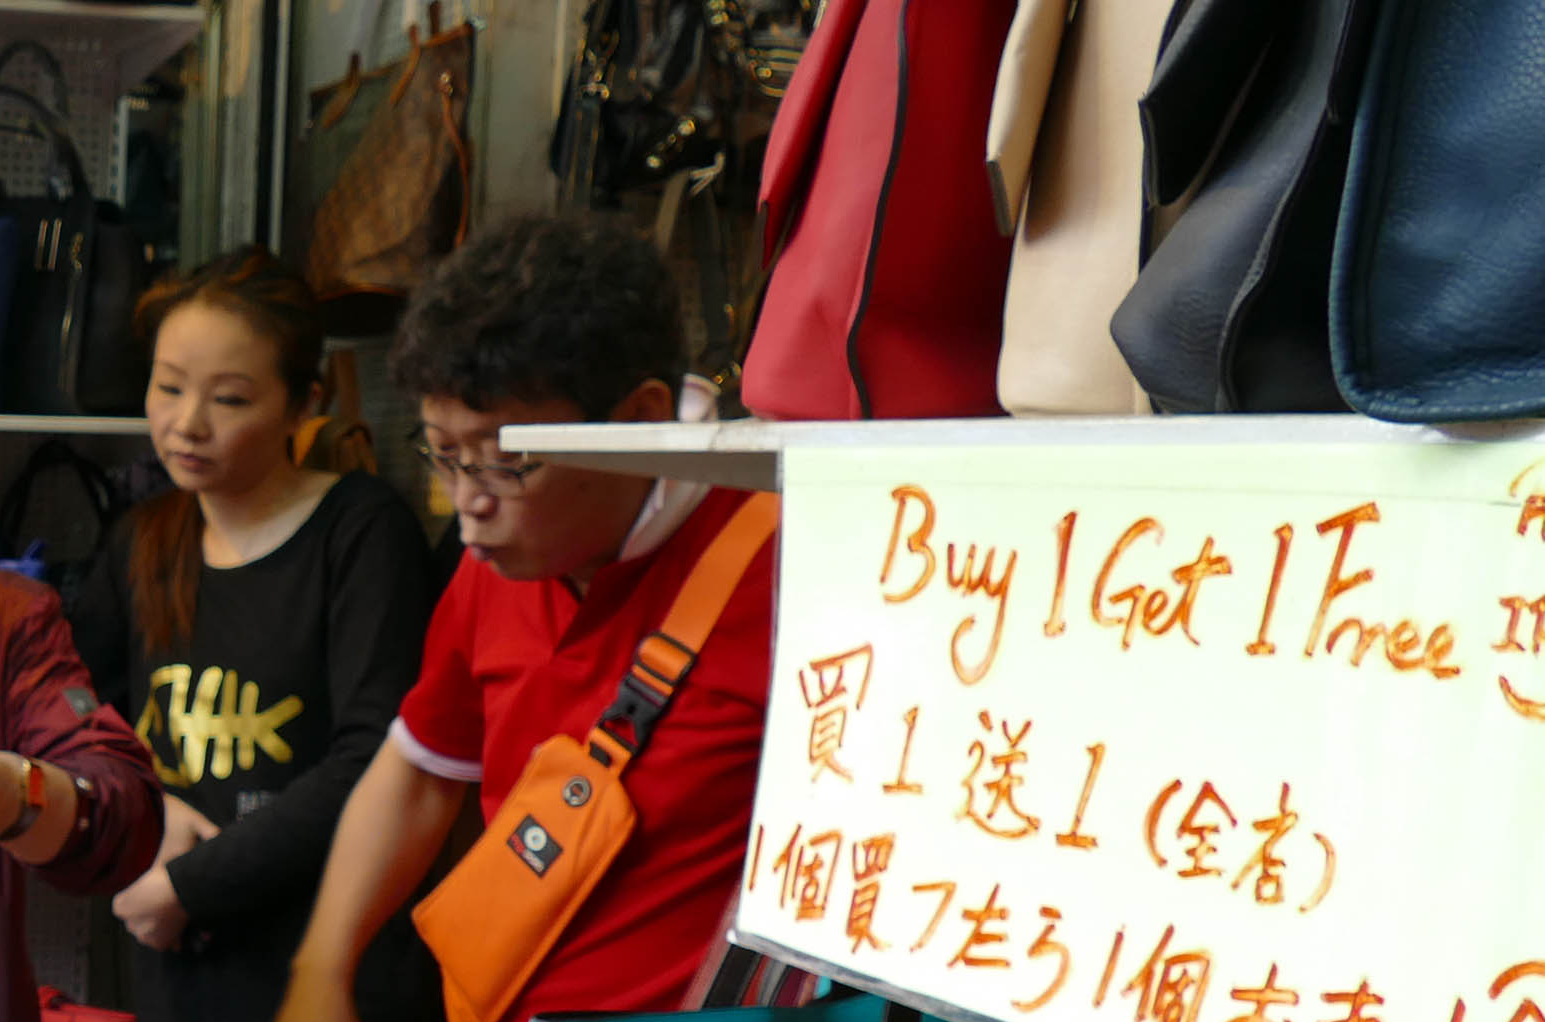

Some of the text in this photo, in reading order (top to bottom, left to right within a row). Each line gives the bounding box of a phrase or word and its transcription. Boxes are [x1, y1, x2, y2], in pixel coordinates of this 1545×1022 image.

[880, 484, 1018, 686] Buy
[1043, 510, 1079, 637] 1
[1091, 516, 1233, 651] Get
[1245, 522, 1295, 656] 1
[1304, 500, 1462, 680] Free
